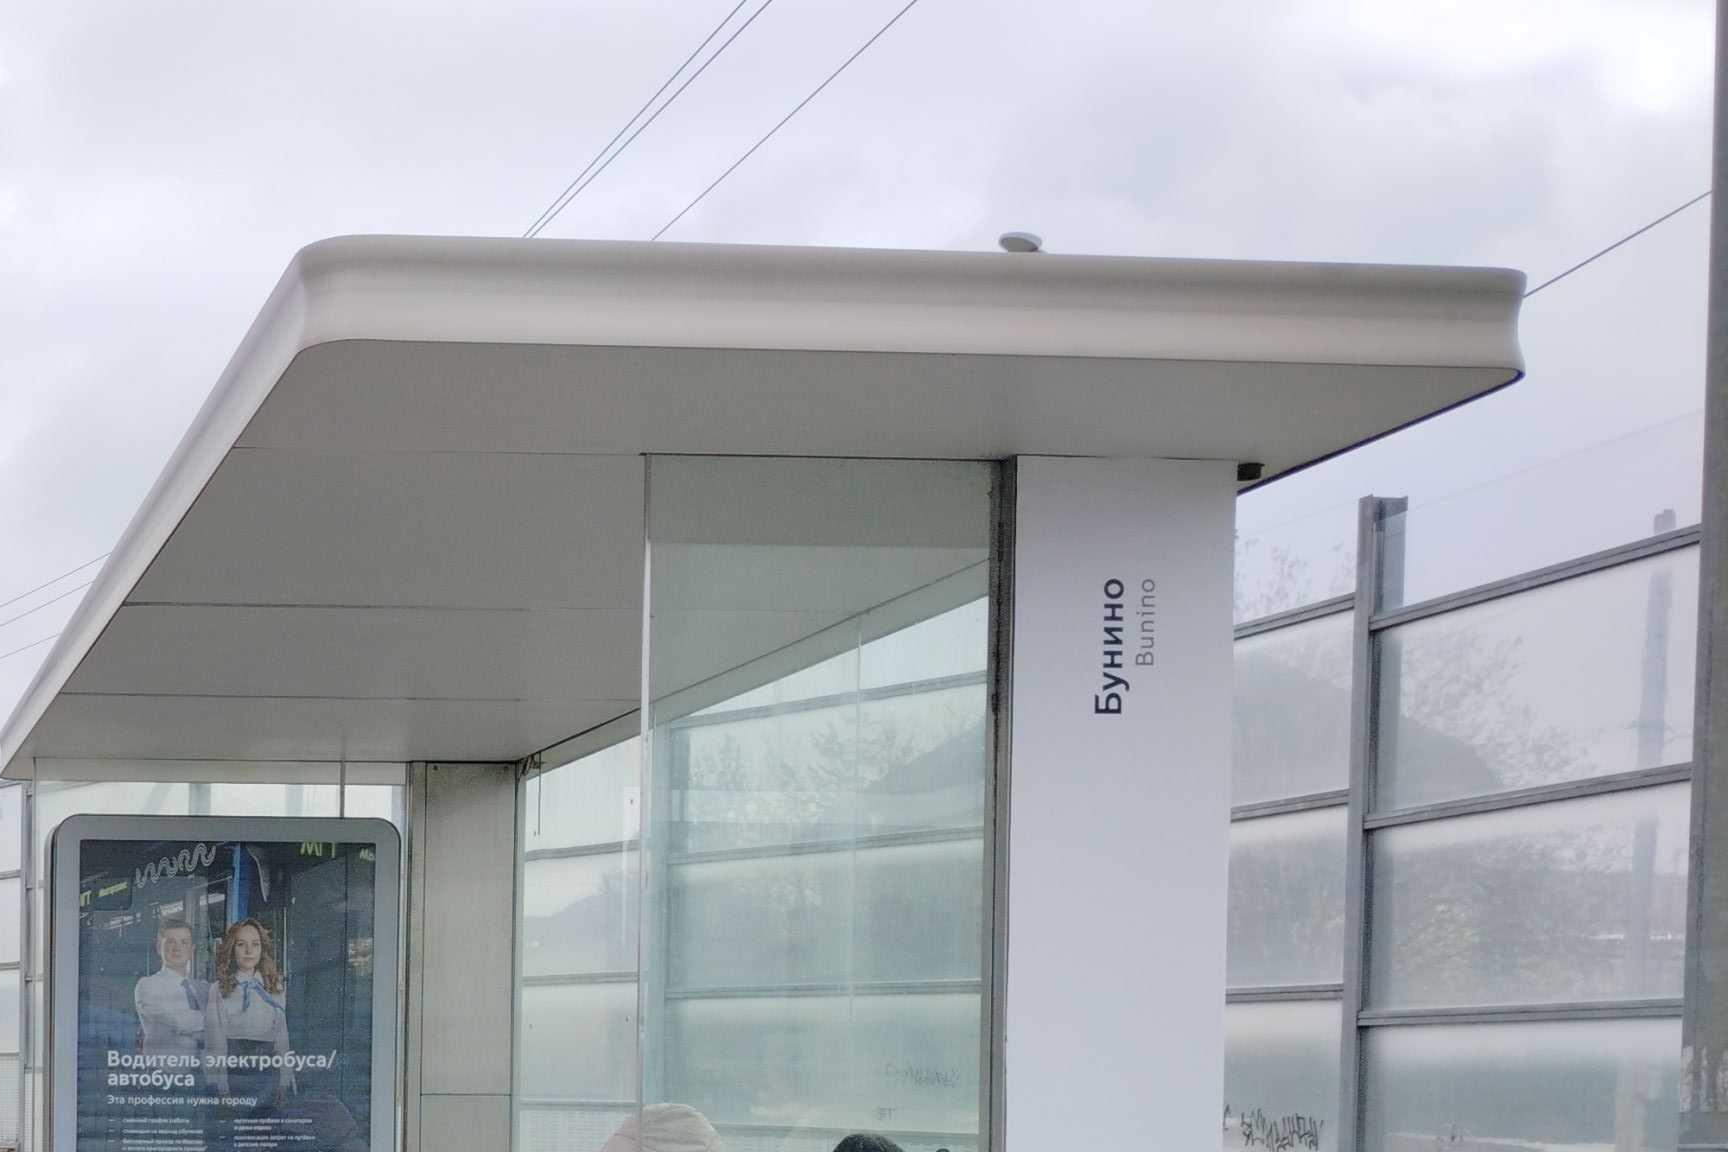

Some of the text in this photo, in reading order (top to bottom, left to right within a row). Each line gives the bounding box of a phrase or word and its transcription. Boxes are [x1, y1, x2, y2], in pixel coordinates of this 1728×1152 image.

[1135, 578, 1156, 667] Bunino
[1094, 578, 1130, 715] Бунино
[106, 1049, 337, 1072] Водитель электробуса/
[107, 1069, 196, 1089] автобуса
[106, 1095, 258, 1107] Эта профессия нужна городу
